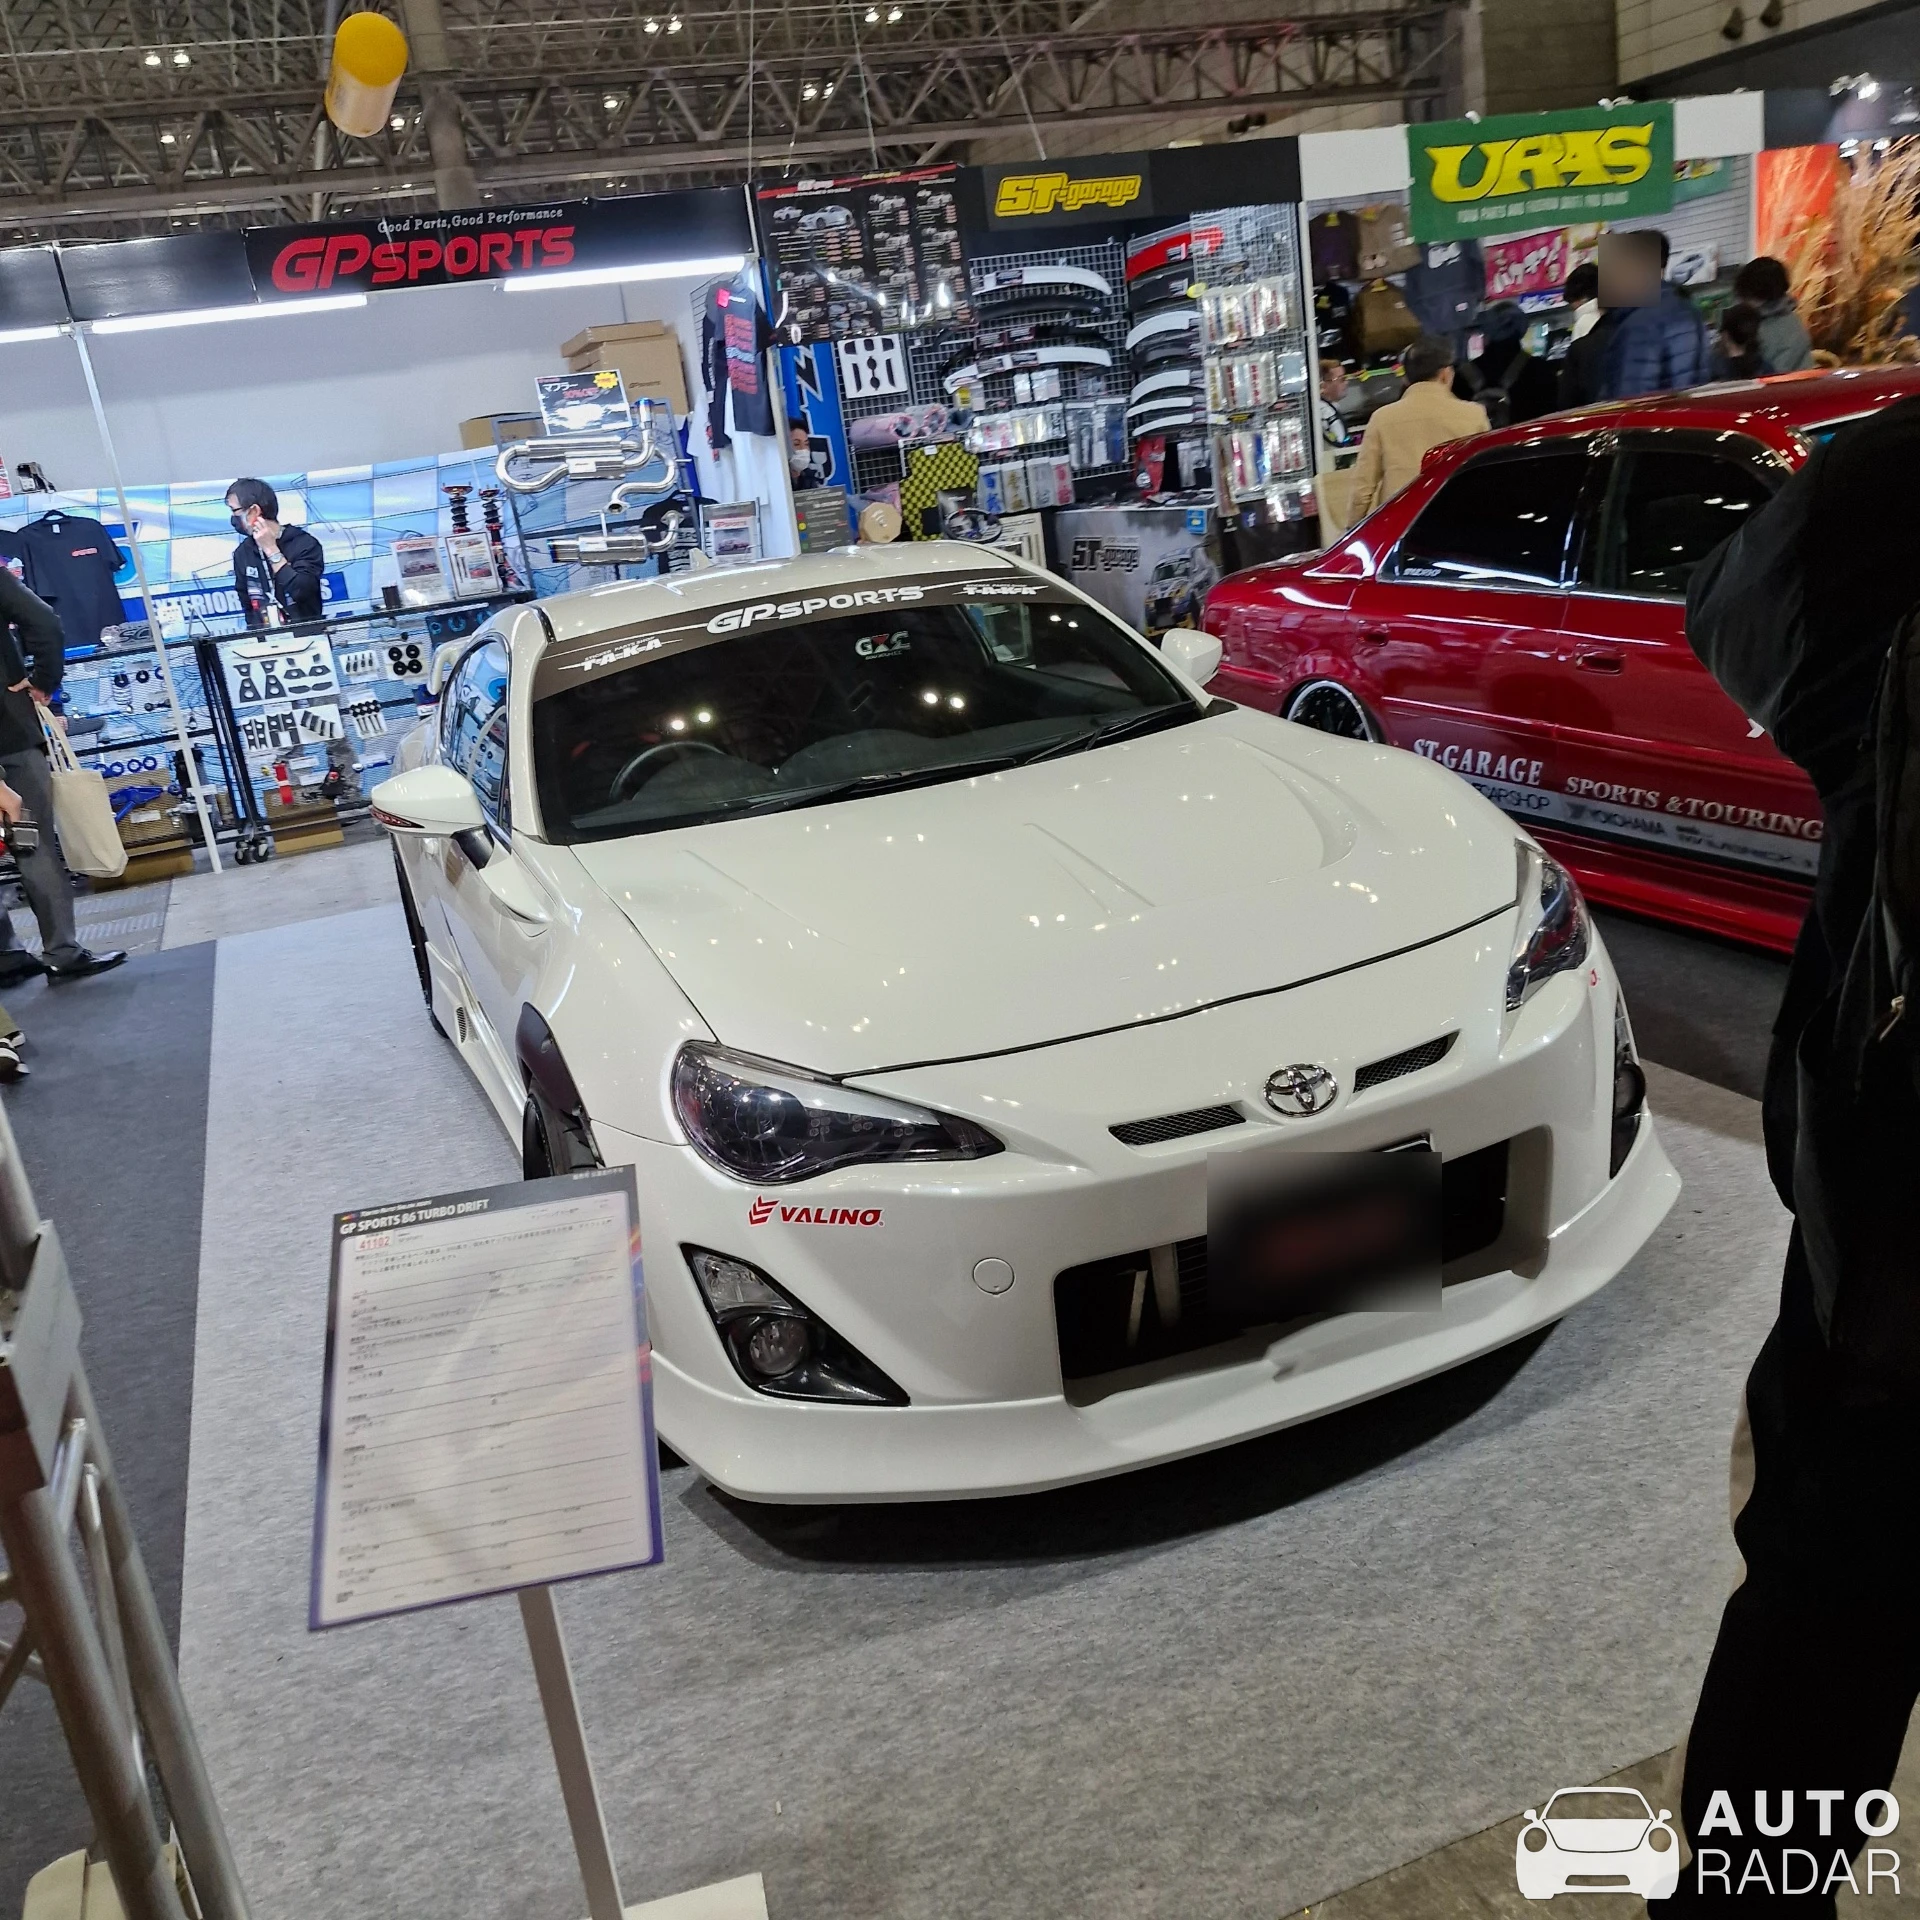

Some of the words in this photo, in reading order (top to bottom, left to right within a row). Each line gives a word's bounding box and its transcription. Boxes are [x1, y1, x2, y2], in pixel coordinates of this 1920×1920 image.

[1424, 121, 1654, 203] URAS
[377, 219, 411, 234] Good
[487, 208, 563, 225] Performance
[542, 381, 579, 393] マフラー
[1565, 776, 1661, 809] SPORTS
[340, 1222, 357, 1235] GP
[358, 1215, 401, 1232] SPORTS
[401, 1212, 416, 1224] 86
[417, 1205, 456, 1221] TURBO
[456, 1199, 490, 1214] DRIFT
[780, 1206, 883, 1226] VALINO
